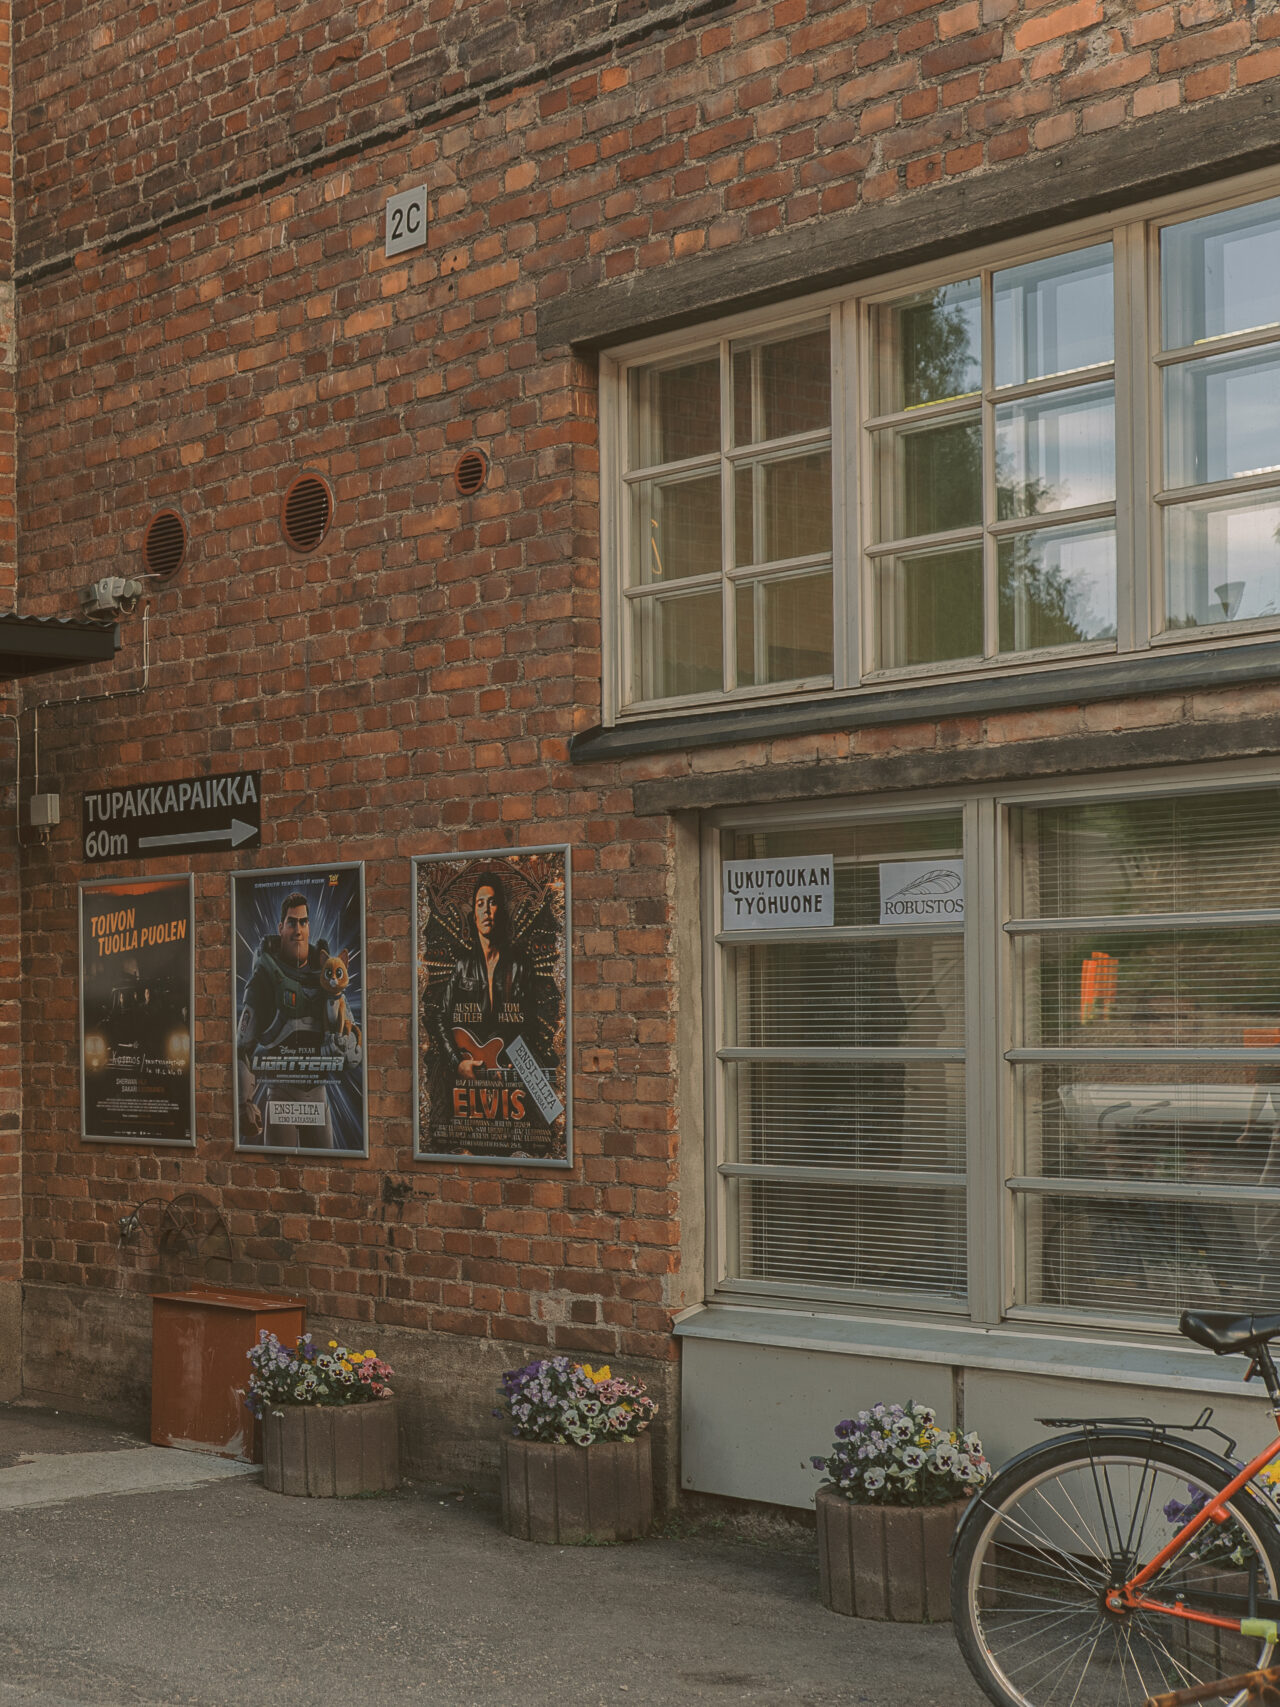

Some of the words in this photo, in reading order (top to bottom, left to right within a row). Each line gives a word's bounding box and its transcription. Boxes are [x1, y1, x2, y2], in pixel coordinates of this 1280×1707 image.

[391, 202, 420, 241] 2C
[85, 775, 258, 822] TUPAKKAPAIKKA
[85, 830, 129, 858] 60m
[727, 867, 830, 895] LUKUTOUKAN
[735, 891, 823, 915] TYÖHUONE
[884, 899, 964, 915] ROBUSTOS
[91, 907, 136, 938] TOIVON
[98, 930, 138, 957] TUOLLA
[140, 919, 187, 947] PUOLEN
[453, 1013, 483, 1023] BUTLER
[454, 1002, 482, 1013] AUSTIN
[498, 1013, 524, 1023] HANKS
[504, 1002, 520, 1013] TOM
[252, 1056, 345, 1071] LIGHTYEAR
[513, 1058, 526, 1076] KINO
[516, 1042, 558, 1110] ENSI-ILTA
[274, 1103, 320, 1116] ENSI-ILTA
[453, 1087, 527, 1120] ELVIS
